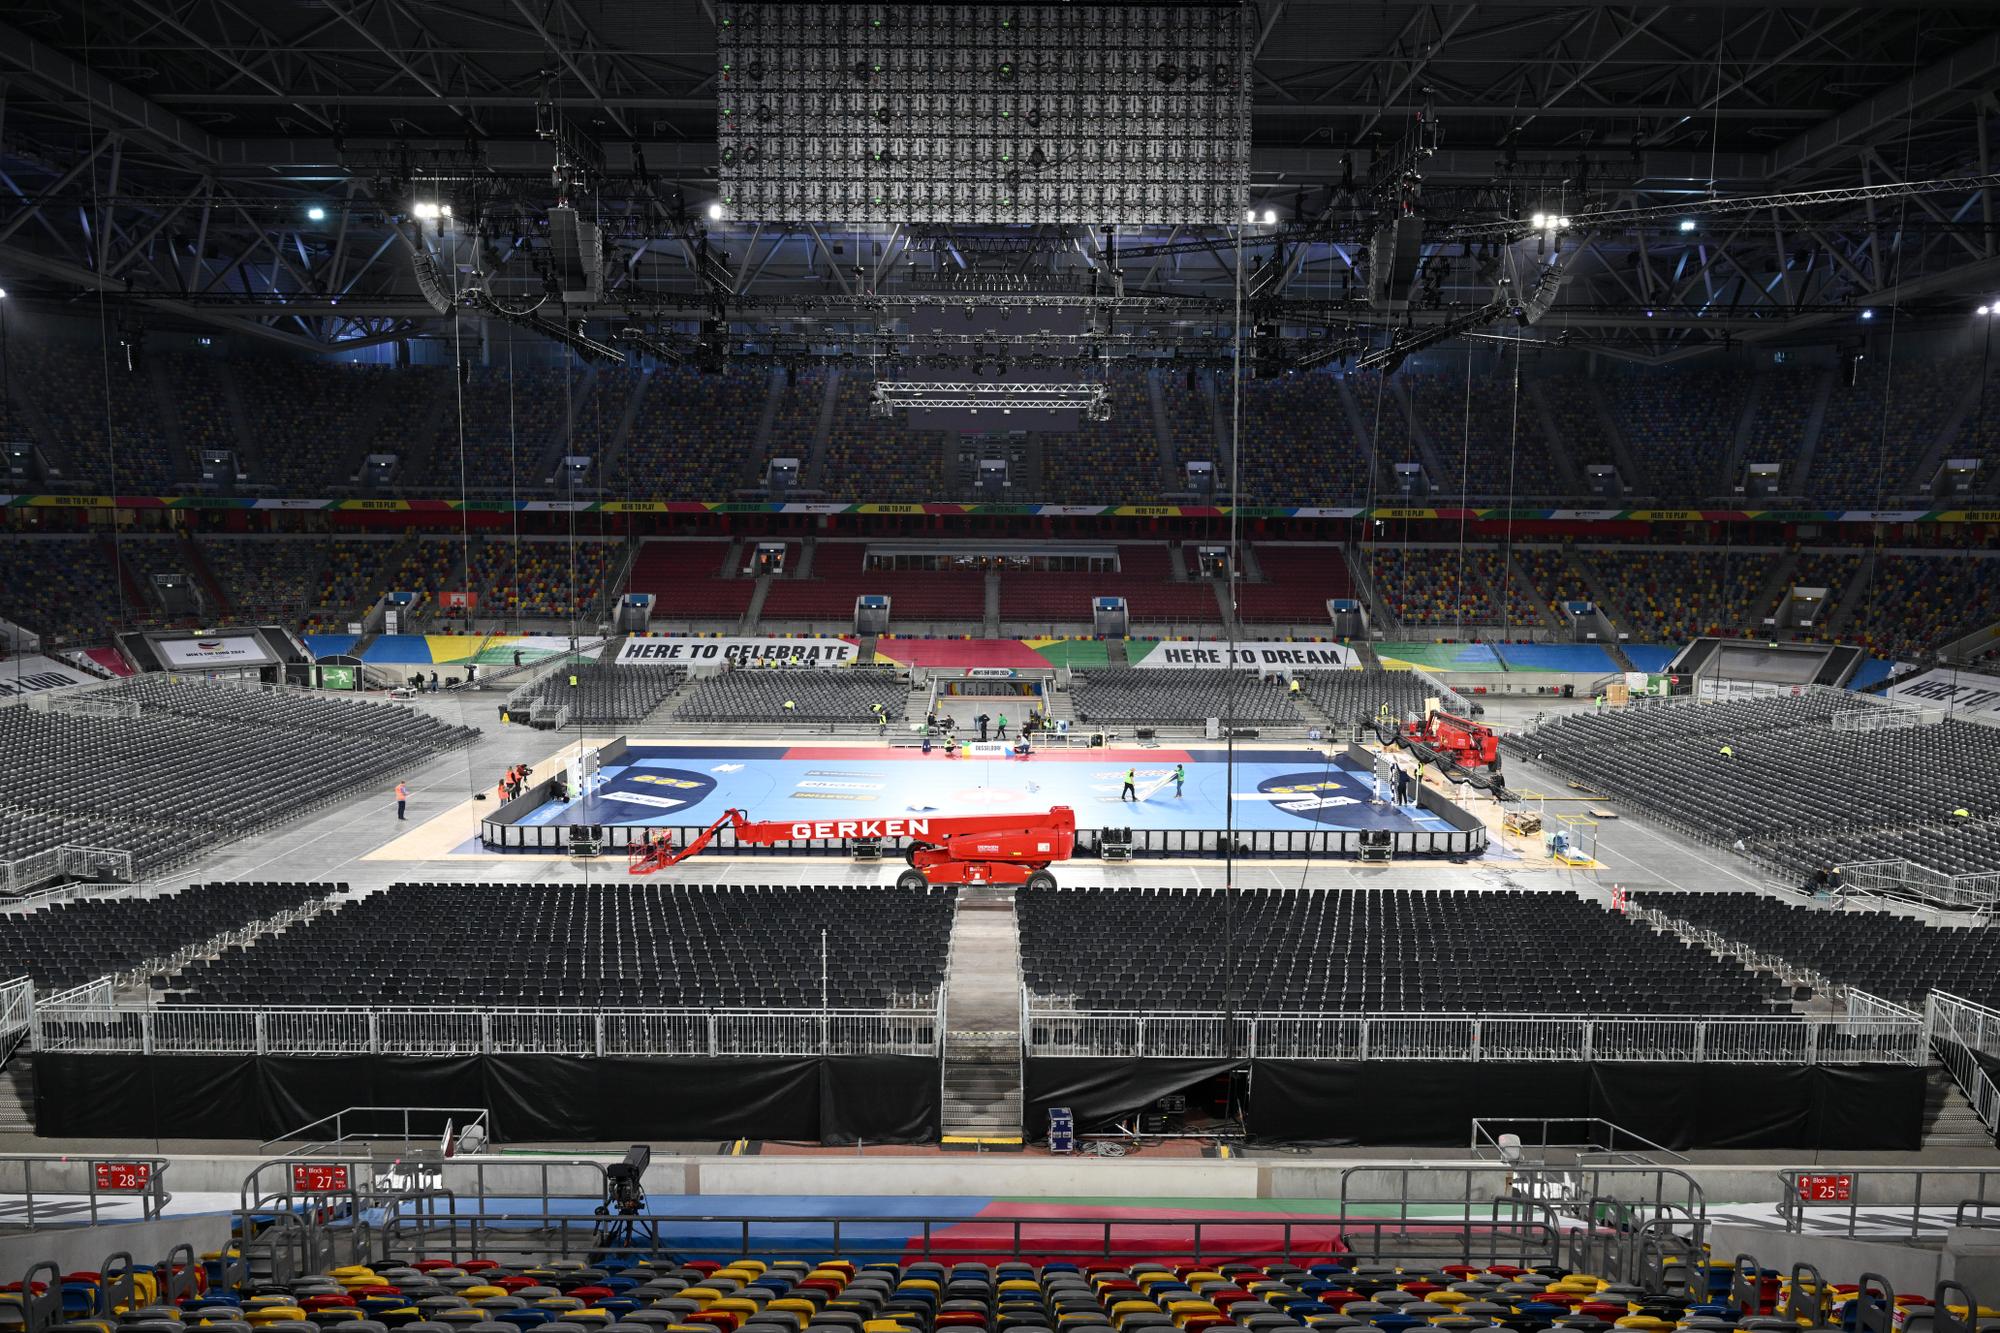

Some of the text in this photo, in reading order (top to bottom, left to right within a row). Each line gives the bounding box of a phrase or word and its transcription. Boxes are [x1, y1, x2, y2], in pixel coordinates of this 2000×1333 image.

[625, 644, 849, 660] HERE TO CELEBRATE
[1164, 649, 1342, 664] HERE TO DREAM
[1899, 680, 1971, 701] HERE
[792, 819, 929, 839] GERKEN
[119, 1174, 136, 1187] 28
[316, 1176, 332, 1188] 27
[1819, 1186, 1835, 1198] 25
